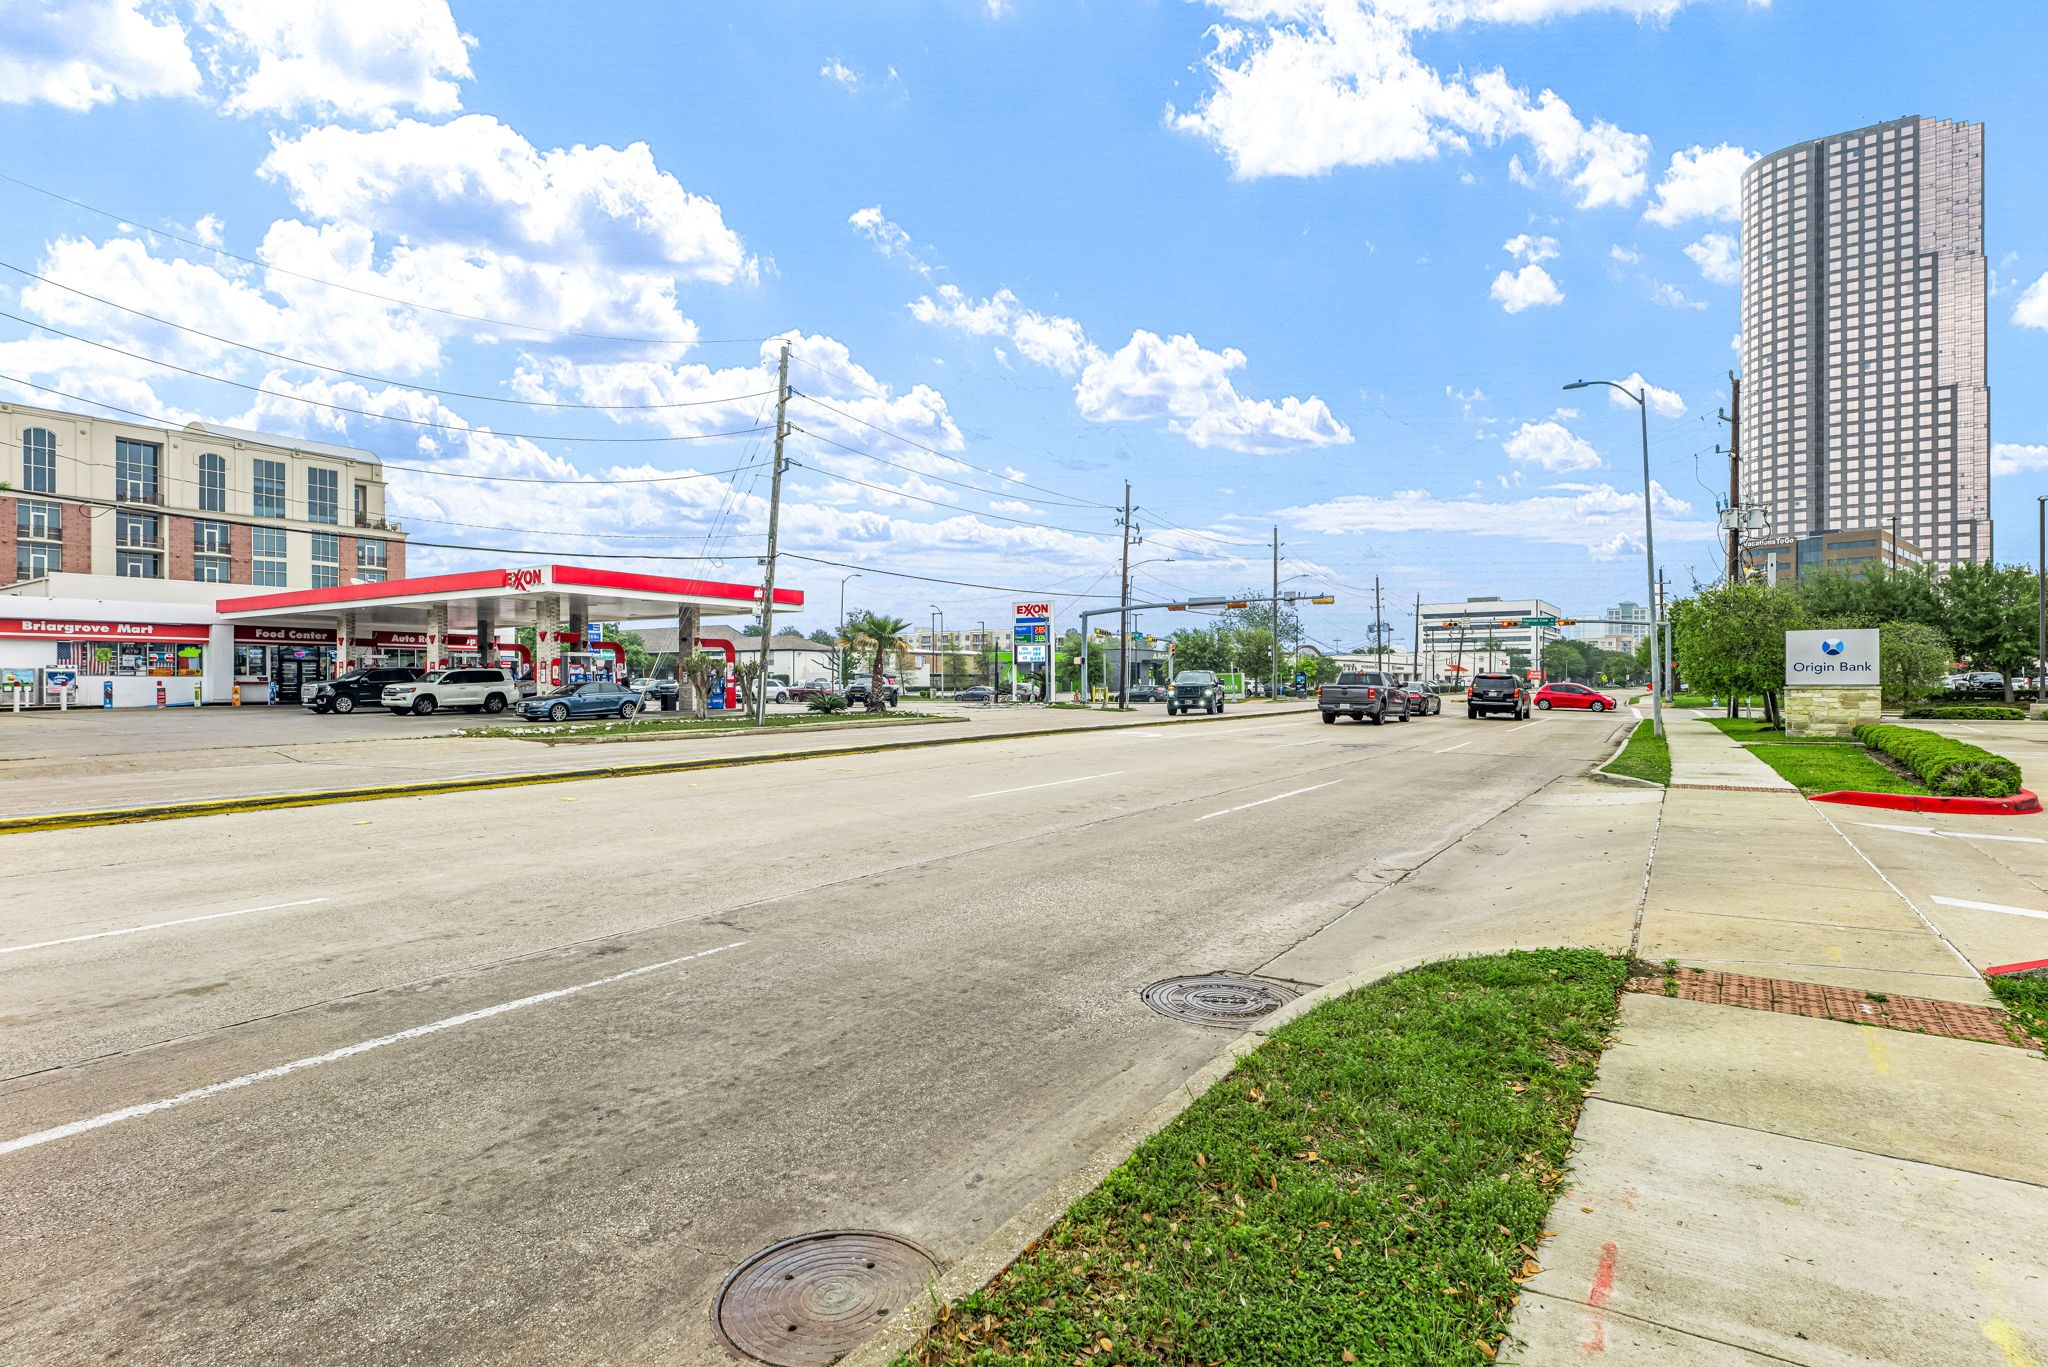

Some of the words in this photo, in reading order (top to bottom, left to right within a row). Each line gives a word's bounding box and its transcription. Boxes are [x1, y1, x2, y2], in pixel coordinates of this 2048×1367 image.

[505, 569, 541, 591] EXXON
[1016, 604, 1048, 617] EXXON
[22, 621, 110, 634] Briargrove
[117, 623, 154, 634] Mart
[255, 628, 285, 639] Food
[289, 630, 328, 640] Center
[391, 634, 415, 643] Auto
[1793, 662, 1835, 674] Origin
[1839, 661, 1872, 672] Bank
